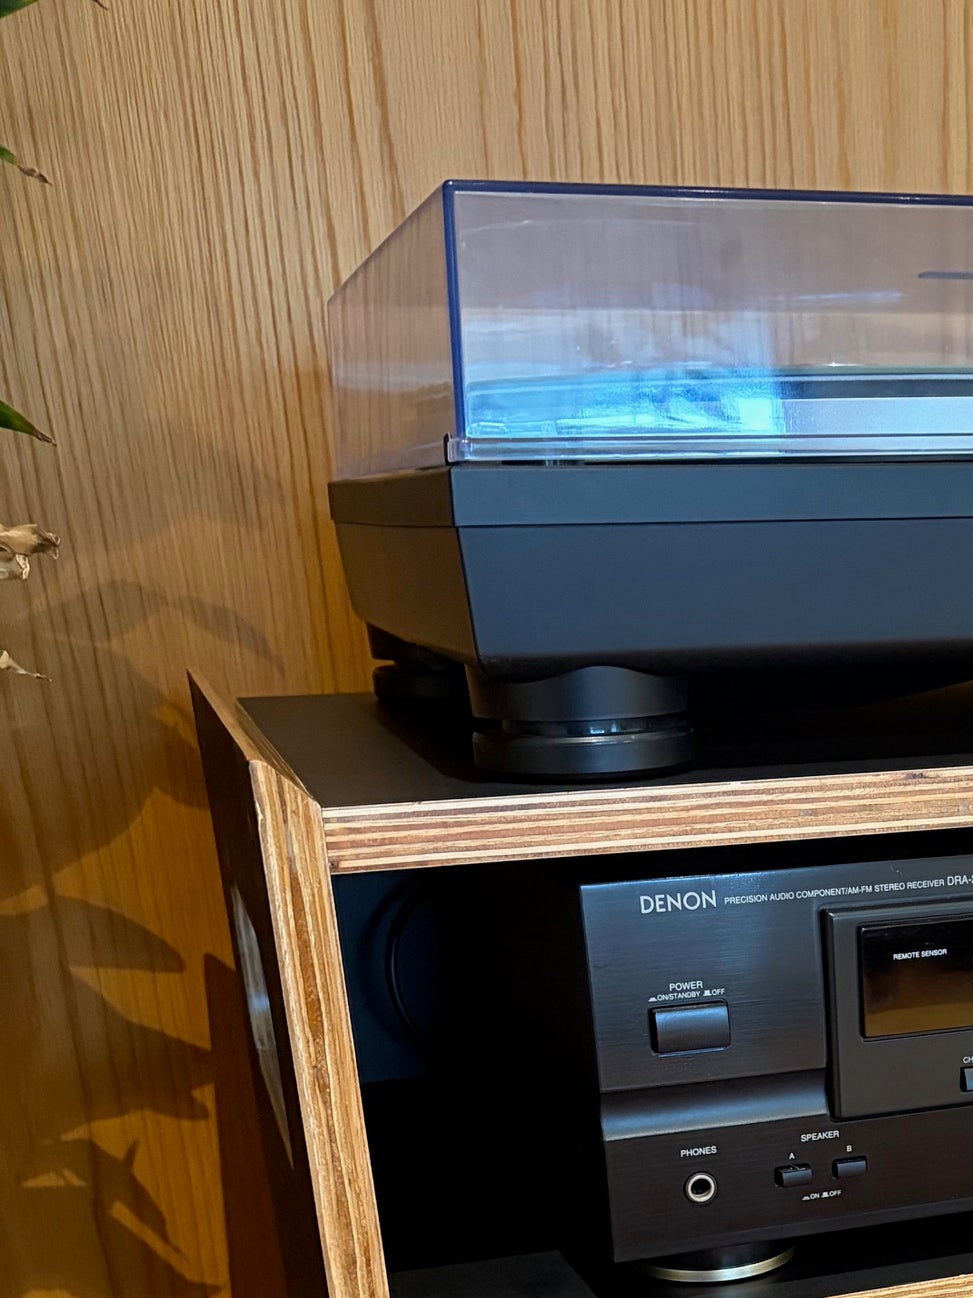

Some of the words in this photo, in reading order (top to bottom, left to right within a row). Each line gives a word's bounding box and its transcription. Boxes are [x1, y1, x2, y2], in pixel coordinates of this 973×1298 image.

[640, 890, 717, 914] DENON
[724, 894, 768, 905] PRECISION
[769, 892, 795, 901] AUDIO
[796, 885, 873, 899] COMPONENT/AM-FM
[874, 882, 905, 892] STEREO
[907, 879, 944, 889] RECEIVER
[893, 951, 920, 960] REMOTE
[921, 949, 947, 958] SENSOR
[669, 980, 703, 991] POWER
[657, 991, 700, 1001] ON/STANDBY
[711, 988, 725, 996] OFF
[801, 1130, 840, 1142] SPEAKER
[680, 1146, 717, 1157] PHONES
